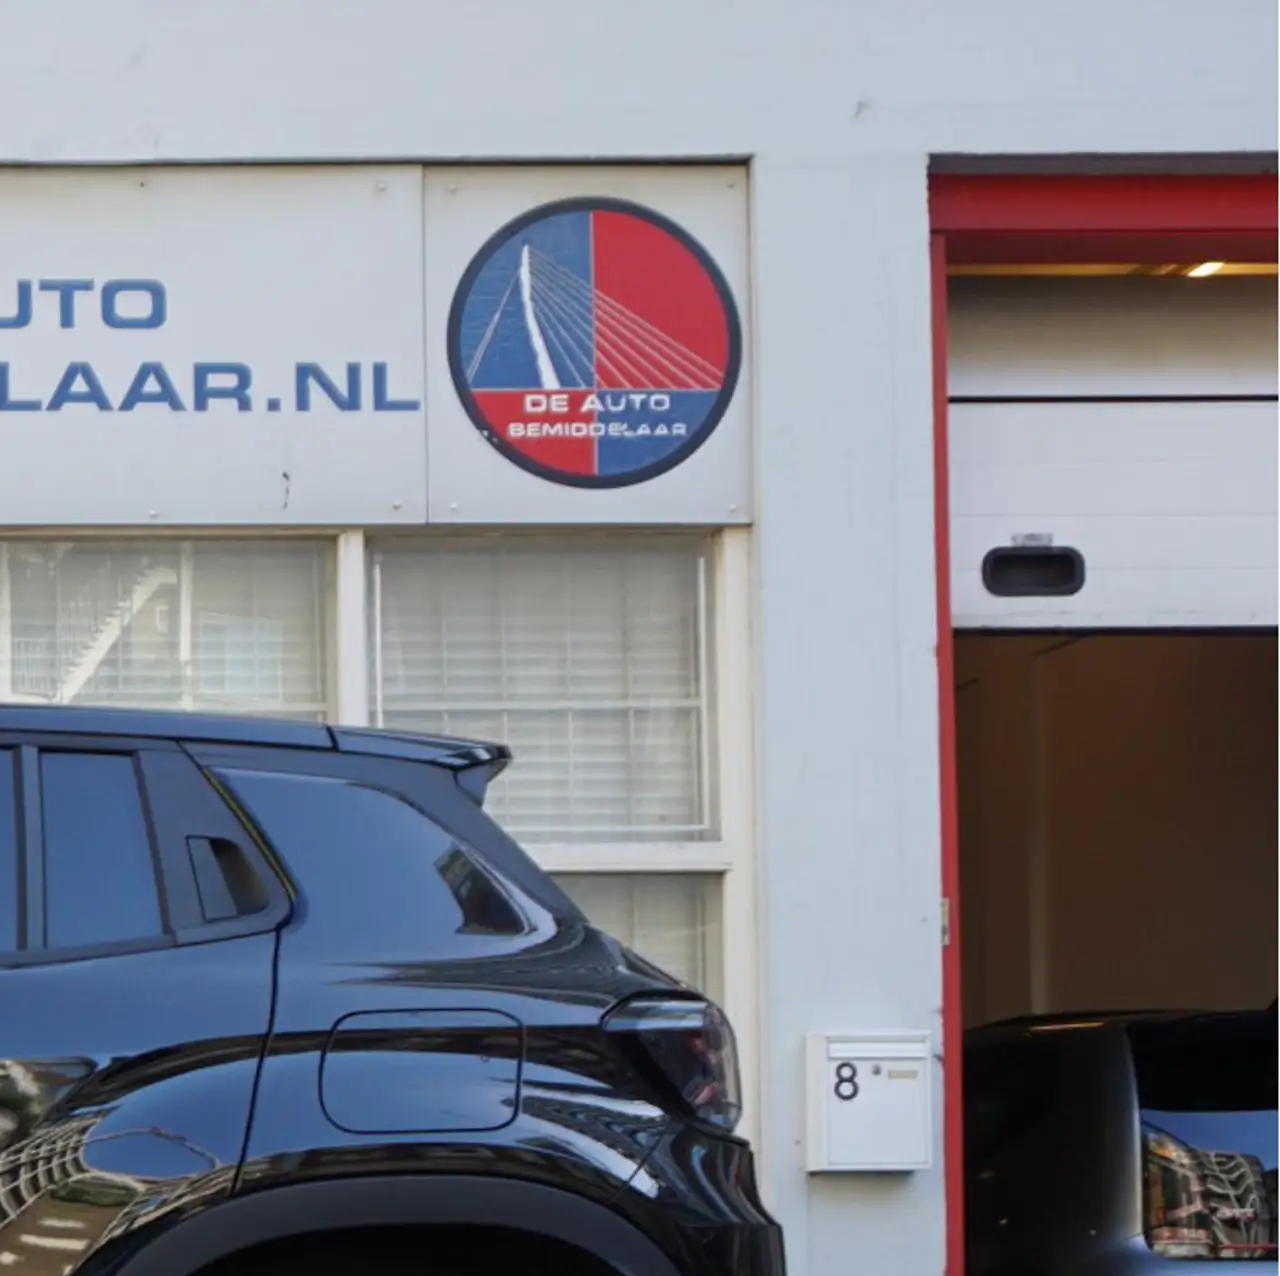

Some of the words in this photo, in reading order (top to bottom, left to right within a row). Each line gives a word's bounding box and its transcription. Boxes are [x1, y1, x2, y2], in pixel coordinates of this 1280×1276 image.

[523, 393, 571, 413] DE
[579, 393, 671, 413] AUTO
[507, 421, 688, 438] BEMIDDELAAR
[833, 1061, 860, 1101] 8
